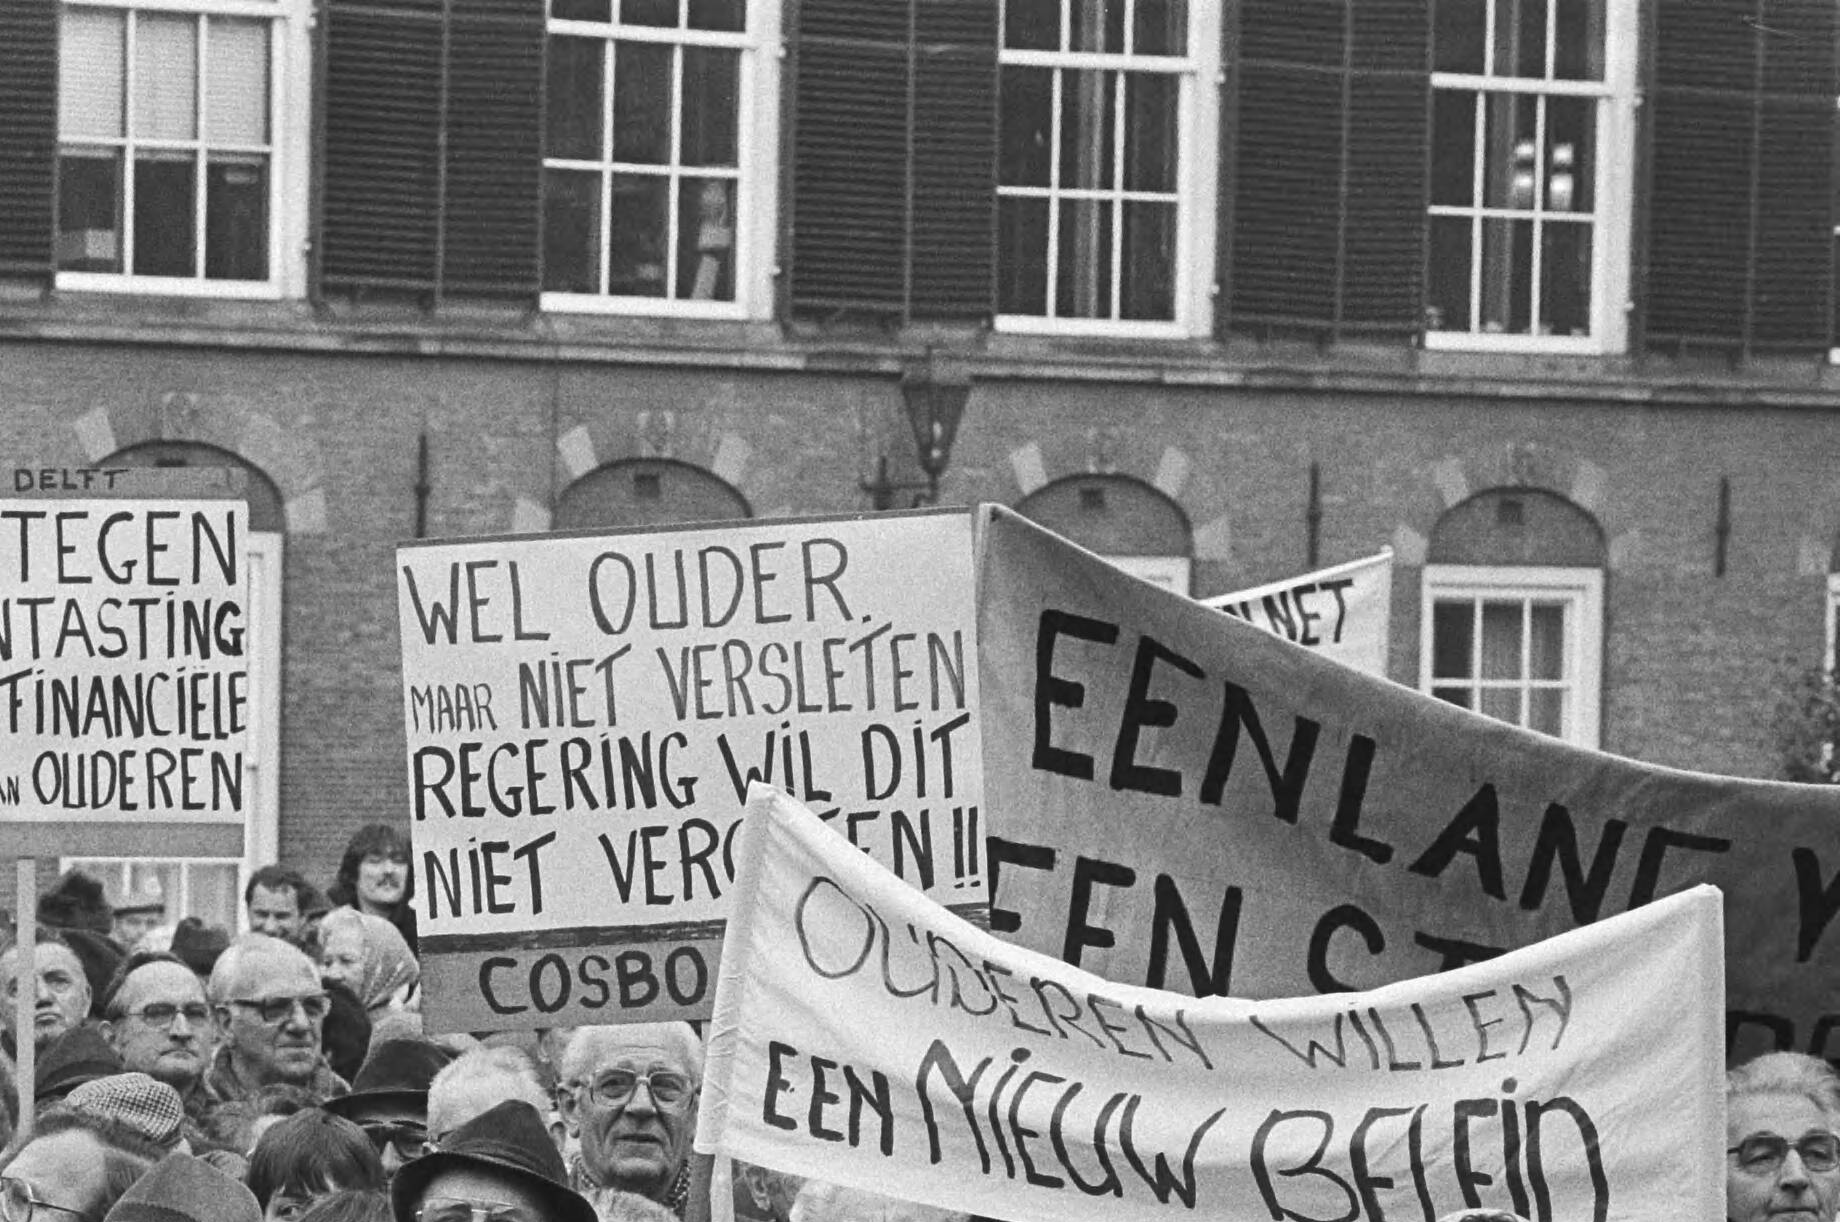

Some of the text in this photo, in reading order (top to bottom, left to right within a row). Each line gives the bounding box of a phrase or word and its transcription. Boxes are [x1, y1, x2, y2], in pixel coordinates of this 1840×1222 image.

[14, 467, 129, 492] DELFT
[0, 510, 238, 586] TEGEN
[403, 559, 550, 645] WEL
[410, 621, 966, 733] MAAR NIET VERSLETEN
[32, 747, 243, 812] OUDEREN
[413, 711, 971, 822] REGERING WIL DIT
[423, 831, 557, 920] NIET
[479, 944, 708, 1016] COSBO
[1248, 975, 1574, 1073] WILLEN
[763, 1041, 892, 1157] EEN
[917, 1039, 1225, 1210] NIEUW
